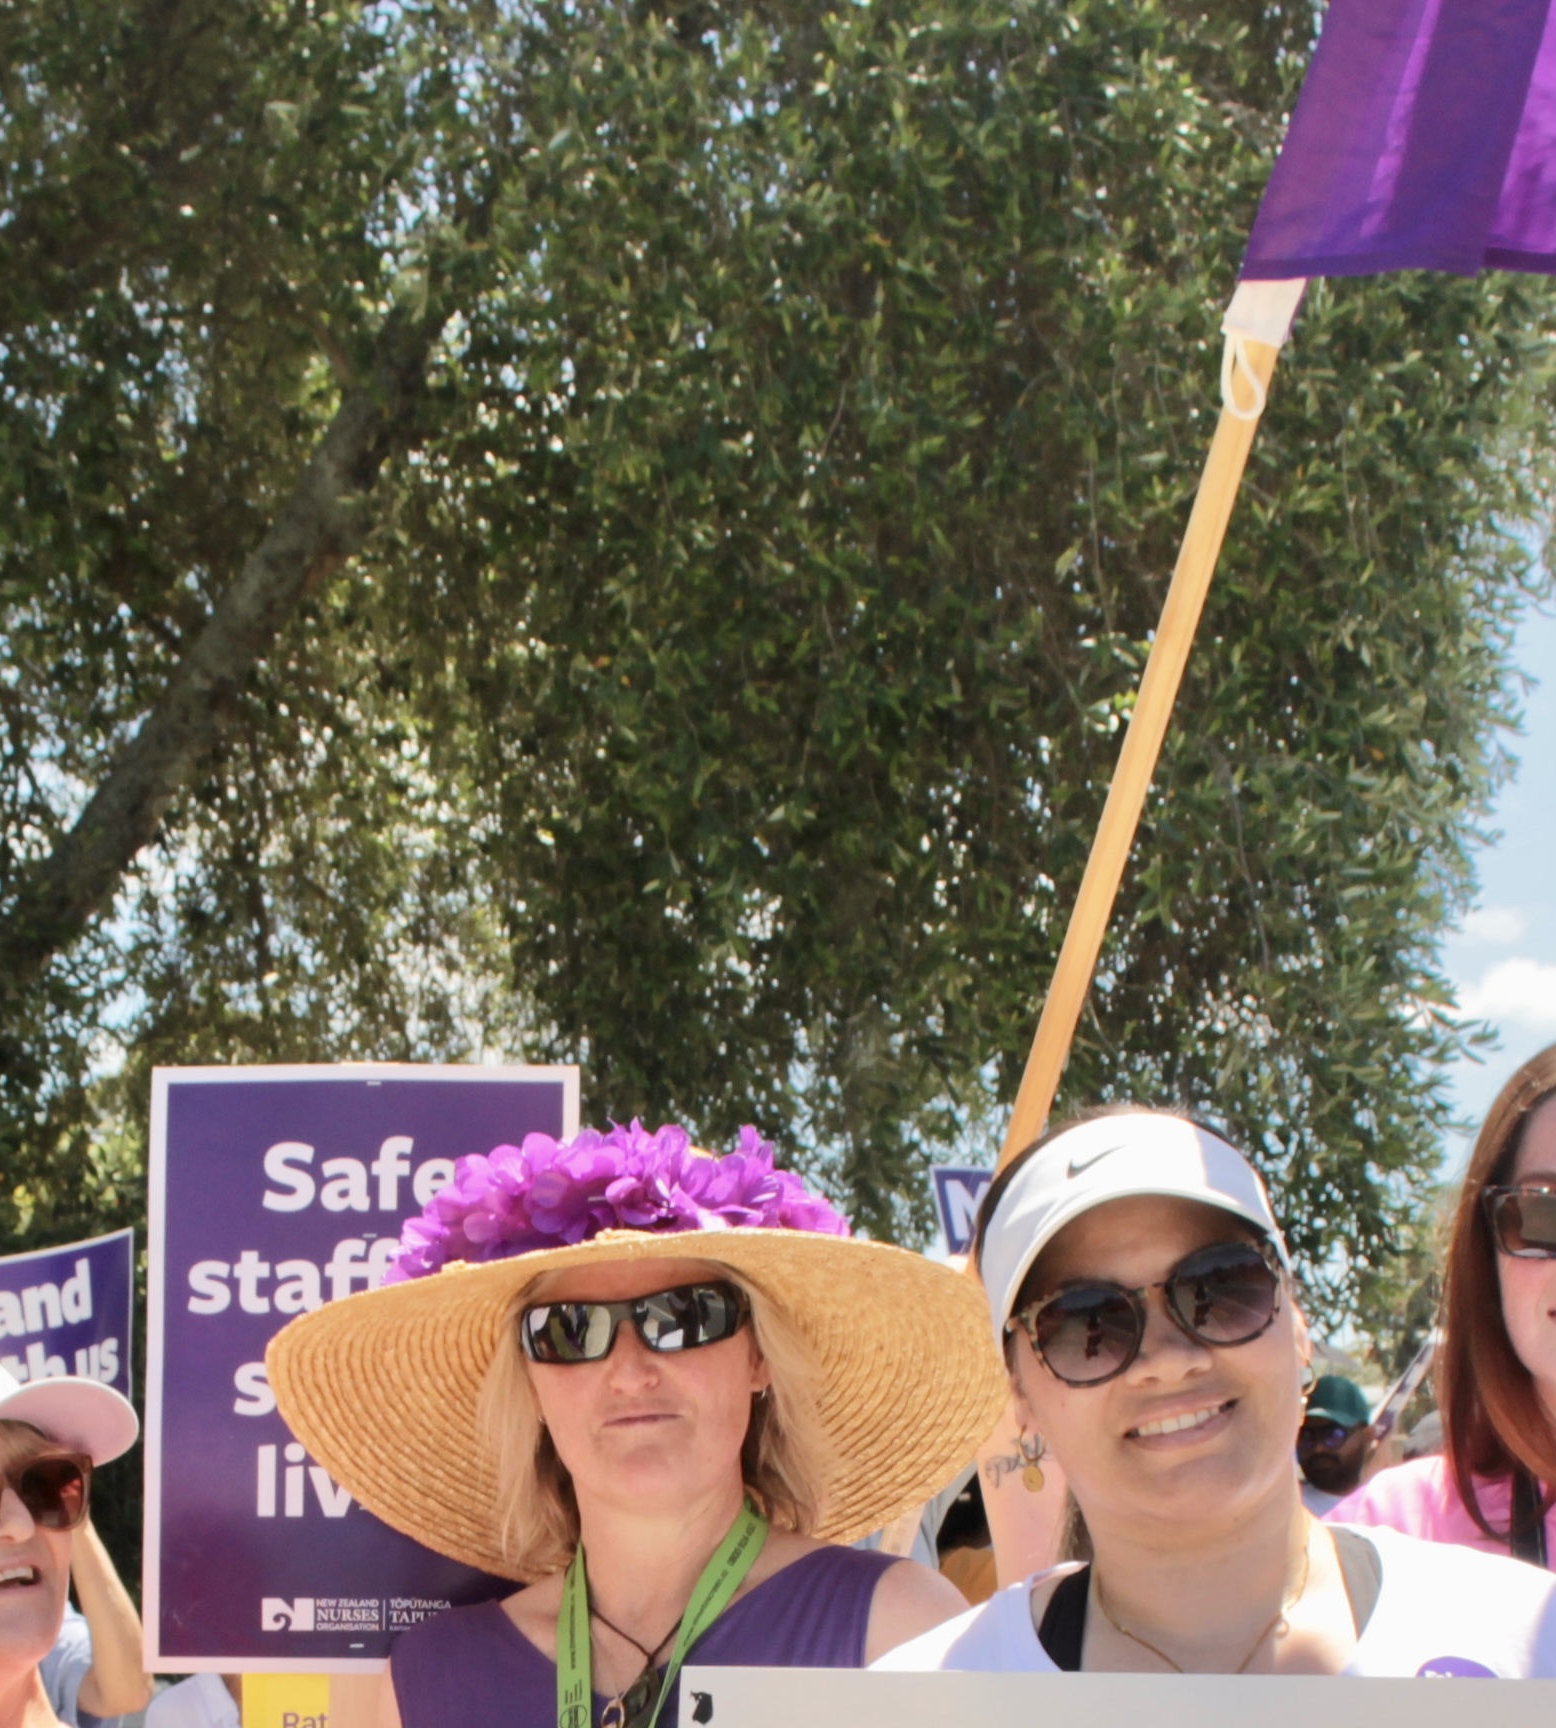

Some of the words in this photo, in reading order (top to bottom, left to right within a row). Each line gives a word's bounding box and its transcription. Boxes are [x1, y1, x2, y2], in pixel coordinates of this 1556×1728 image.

[262, 1135, 456, 1212] Safe
[187, 1238, 400, 1314] staff
[75, 1337, 119, 1384] us
[316, 1599, 336, 1608] NEW
[338, 1599, 379, 1608] ZEALAND
[316, 1608, 379, 1621] NURSES
[390, 1611, 437, 1624] TAP
[316, 1623, 379, 1632] ORGANISATION
